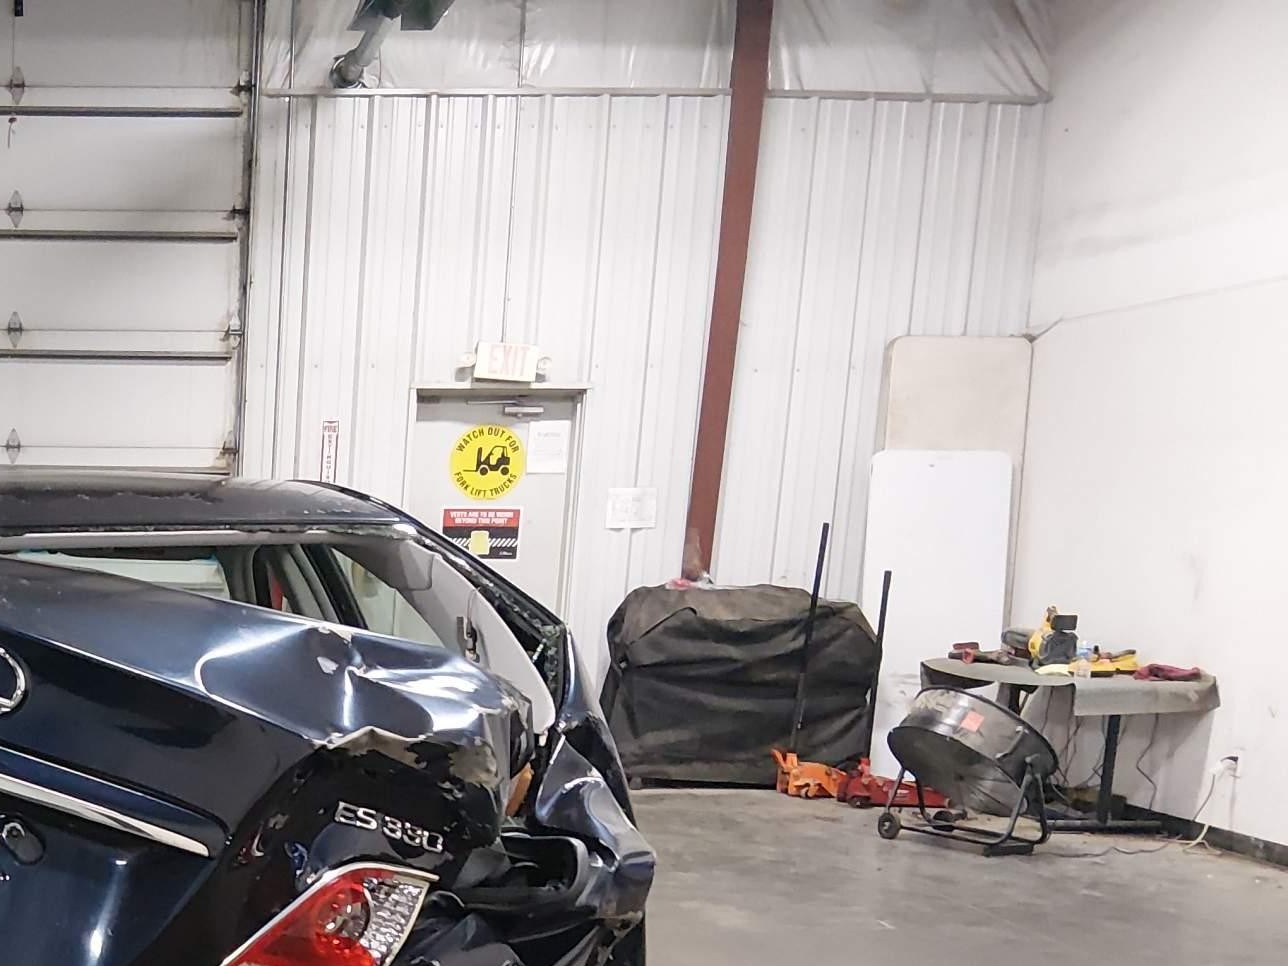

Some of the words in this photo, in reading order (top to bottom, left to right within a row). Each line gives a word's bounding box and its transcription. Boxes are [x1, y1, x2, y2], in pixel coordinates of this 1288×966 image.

[488, 344, 530, 376] EXIT
[456, 428, 485, 452] WATCH
[488, 427, 506, 438] OUT
[505, 436, 519, 453] FOR
[454, 472, 470, 490] FORK
[470, 487, 487, 497] LIFT
[489, 473, 517, 496] TRUCKS
[334, 801, 378, 830] ES
